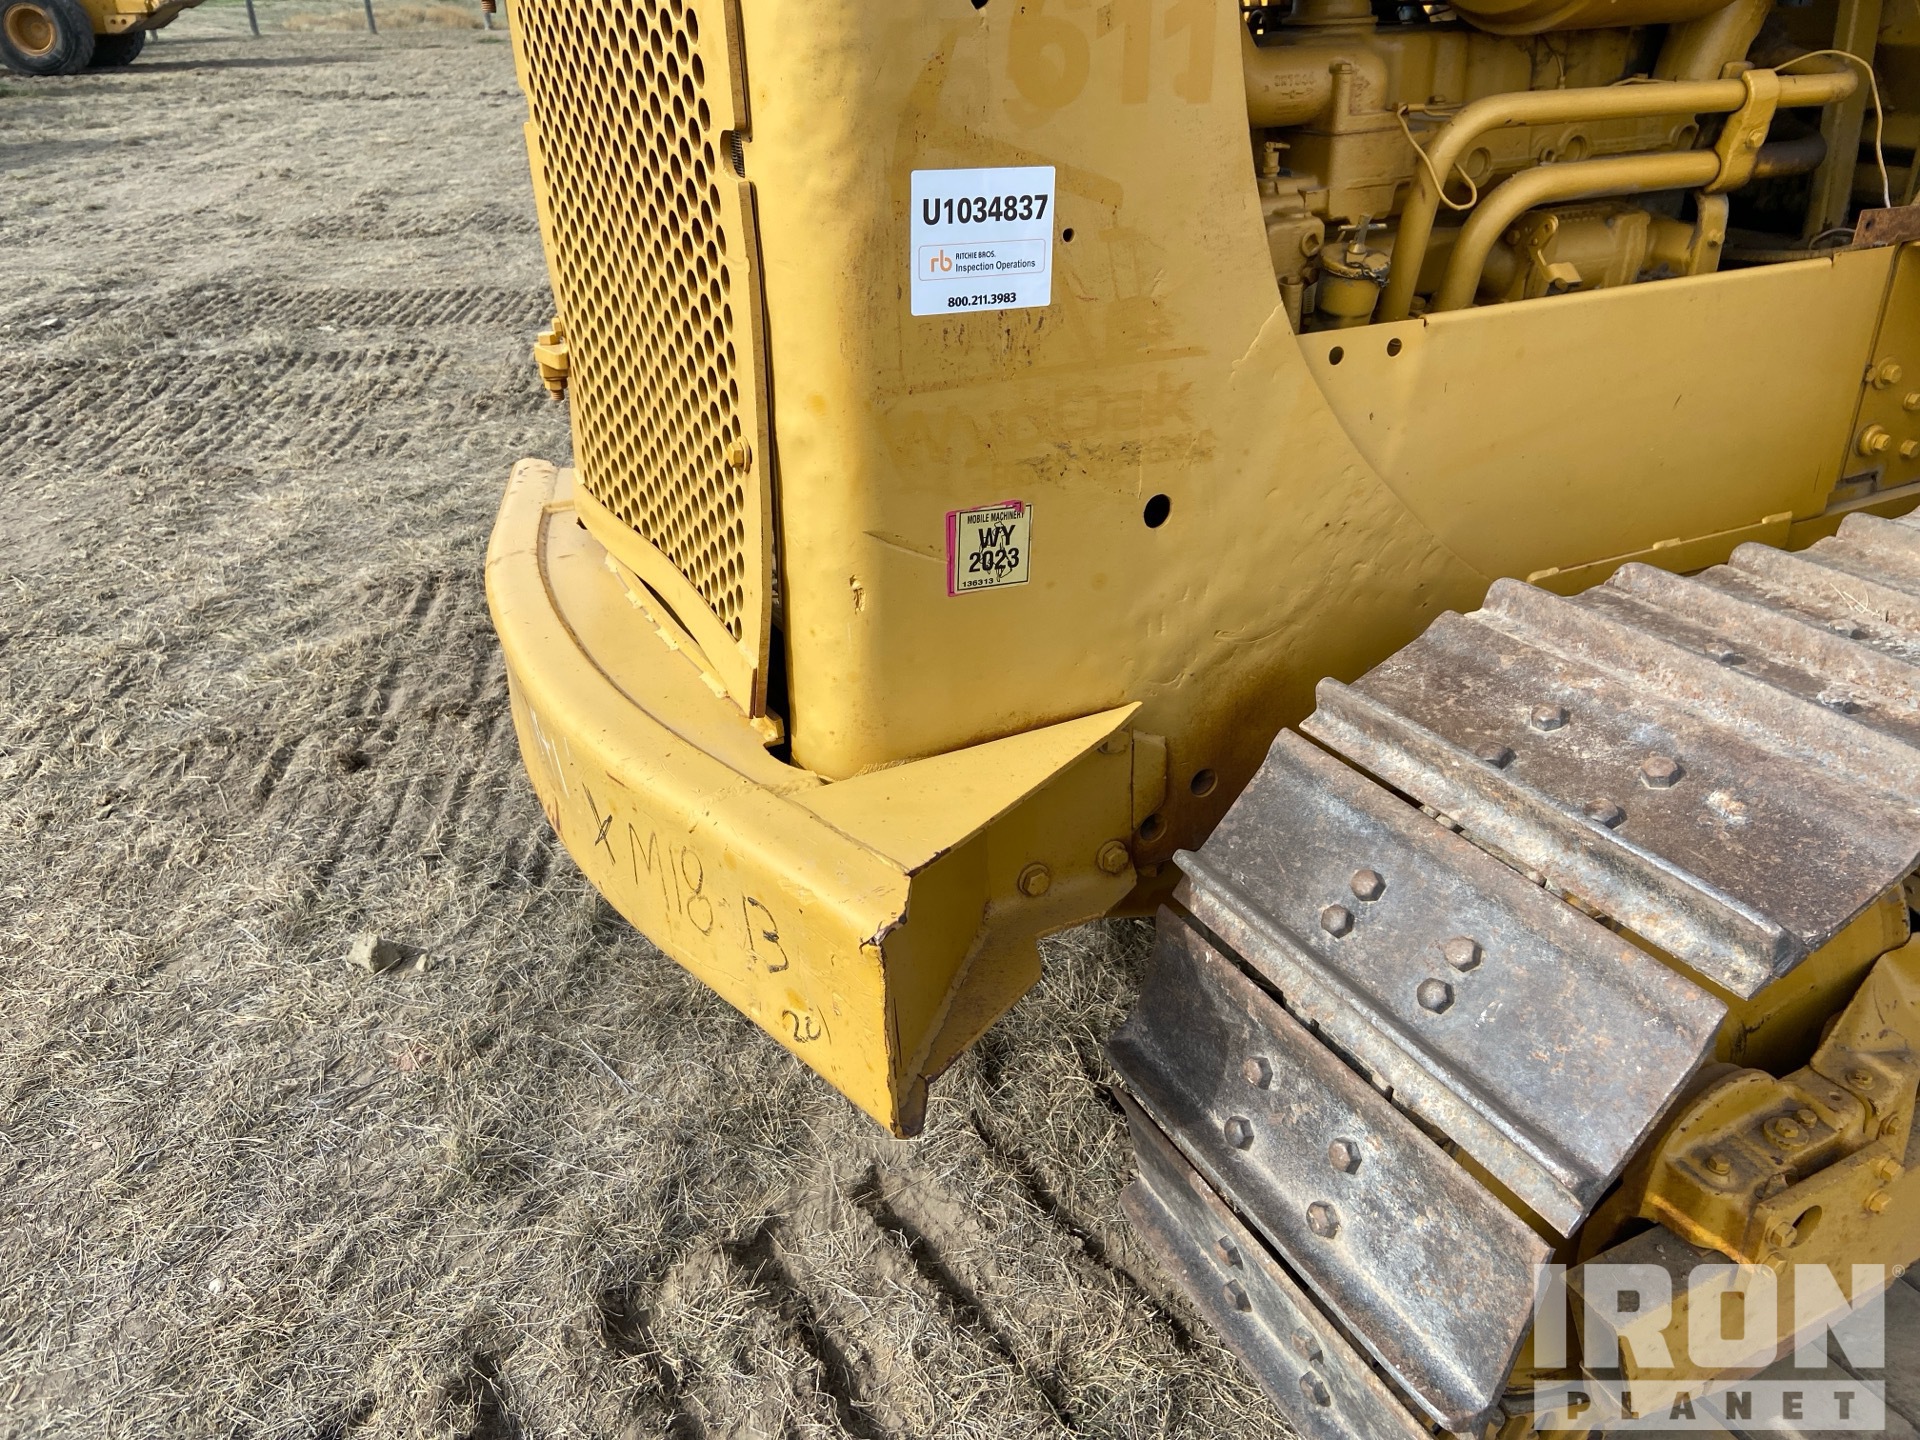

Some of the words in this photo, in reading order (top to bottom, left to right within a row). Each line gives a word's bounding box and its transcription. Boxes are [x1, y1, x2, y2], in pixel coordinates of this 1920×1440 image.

[923, 194, 1048, 225] U1034837
[930, 249, 953, 272] rb
[955, 252, 977, 260] RITCHIE
[978, 250, 996, 258] BROS.
[955, 262, 994, 273] Inspection
[995, 259, 1036, 271] Operations
[947, 292, 1017, 308] 800.211.3983
[967, 512, 990, 525] MOBILE
[978, 524, 1016, 548] WY
[968, 547, 1020, 573] 2023
[962, 577, 994, 588] 136313
